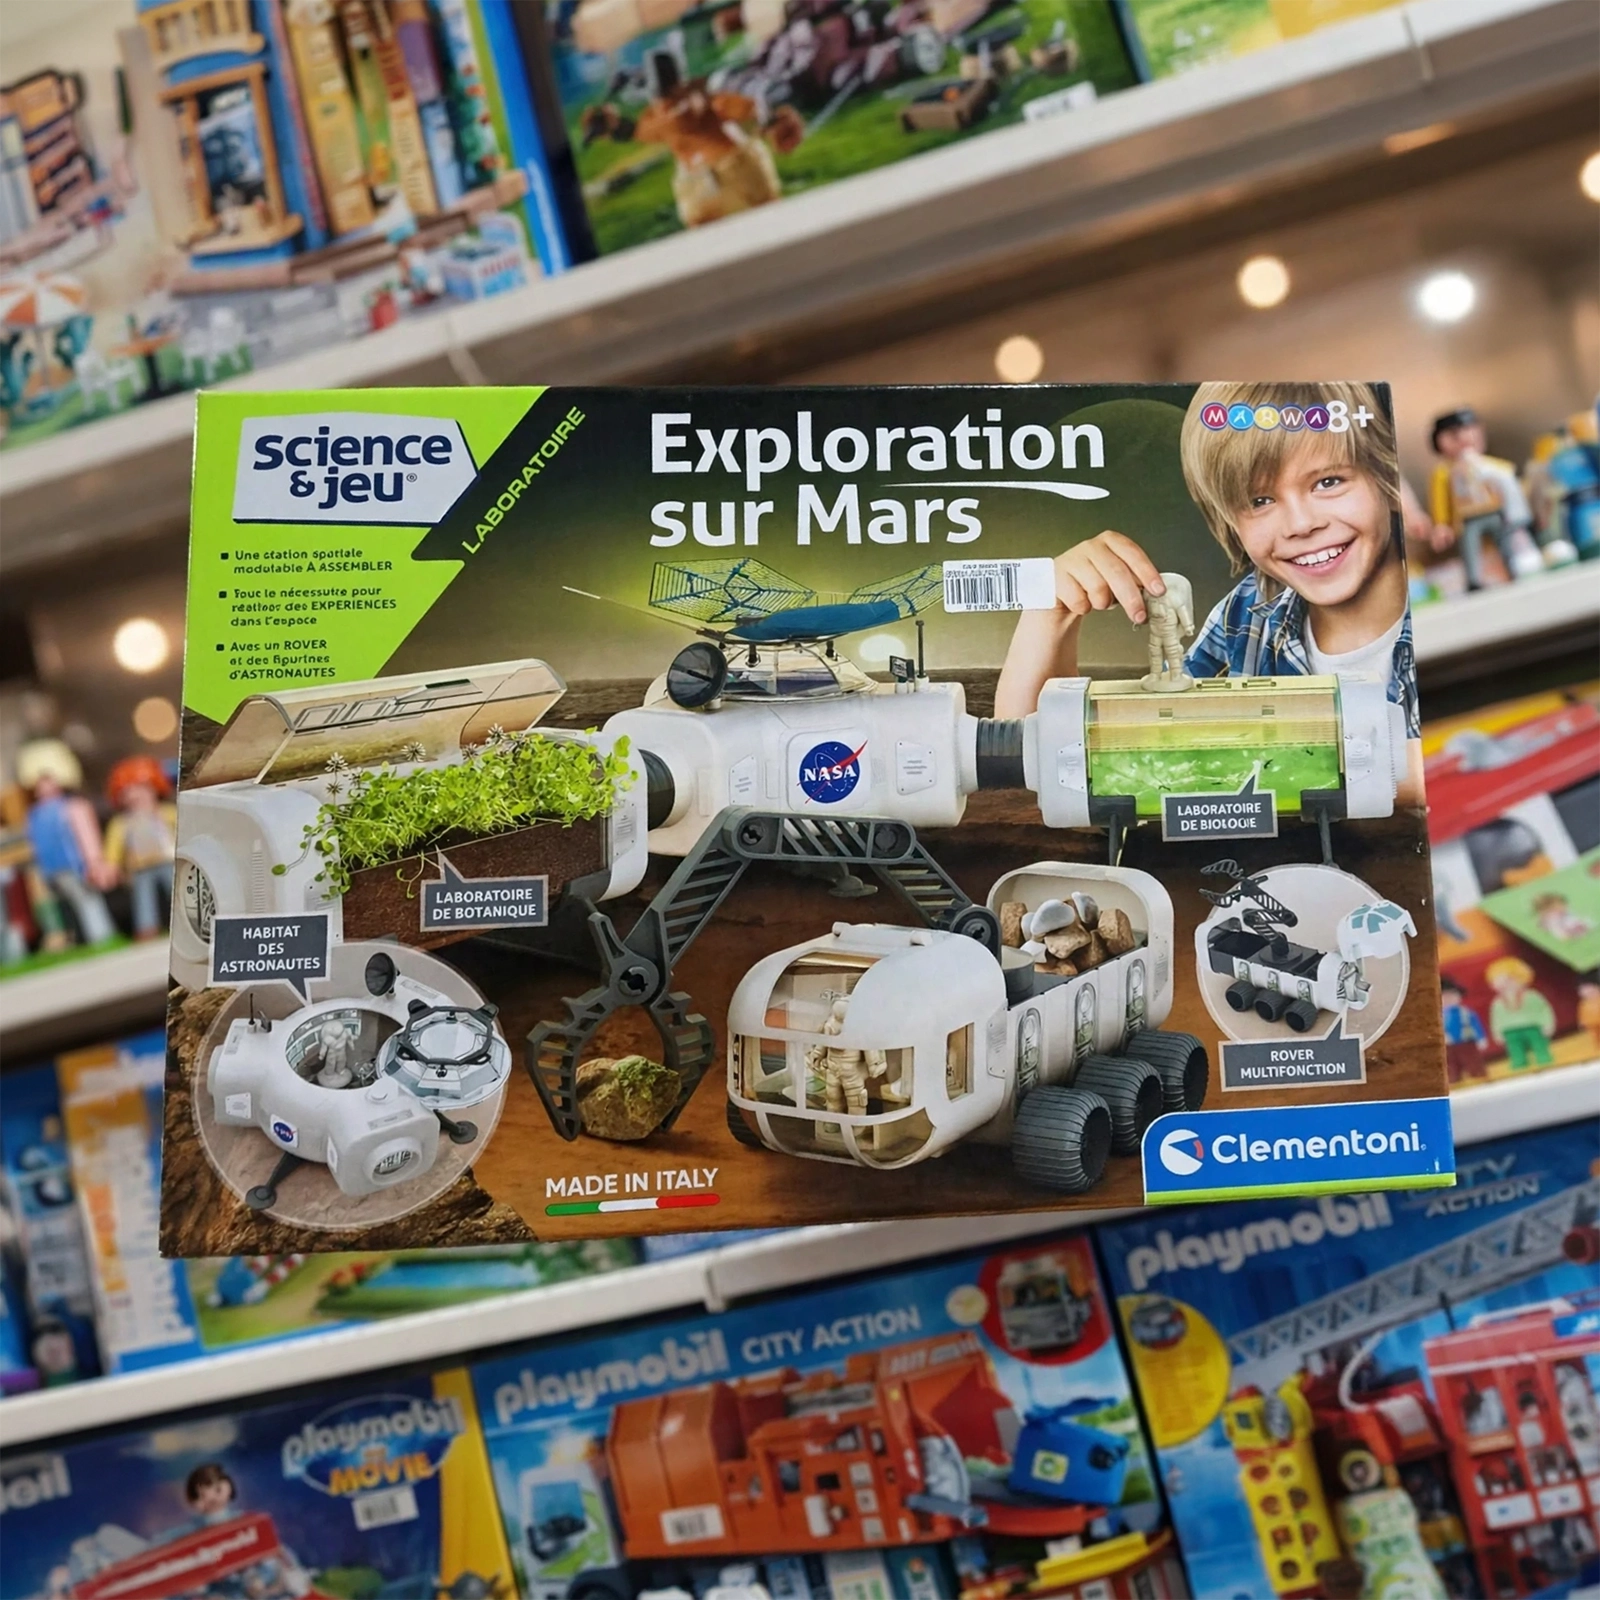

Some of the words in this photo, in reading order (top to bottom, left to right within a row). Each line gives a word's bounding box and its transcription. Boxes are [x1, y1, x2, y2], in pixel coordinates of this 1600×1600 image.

[1326, 400, 1374, 433] 8+
[650, 408, 1105, 492] Exploration
[290, 470, 315, 498] &
[461, 406, 586, 554] LABORATOIRE
[649, 499, 774, 547] sur
[797, 483, 983, 546] Mars
[235, 549, 260, 560] Une
[319, 560, 393, 572] ASSEMBLER
[351, 587, 382, 598] pour
[230, 616, 261, 627] dans
[264, 641, 280, 651] un
[283, 639, 328, 650] ROVER
[803, 764, 857, 783] NASA
[1177, 802, 1262, 817] LABORATOIRE
[1180, 818, 1198, 831] DE
[435, 888, 533, 905] LABORATOIRE
[432, 907, 451, 920] DE
[455, 903, 537, 920] BOTANIQUE
[242, 925, 301, 940] HABITAT
[257, 942, 284, 955] DES
[219, 956, 320, 974] ASTRONAUTES
[1270, 1049, 1314, 1062] ROVER
[1240, 1062, 1346, 1079] MULTIFONCTION
[1211, 1122, 1421, 1165] Clementoni
[546, 1174, 618, 1198] MADE
[624, 1172, 648, 1193] IN
[656, 1168, 719, 1191] ITALY
[1424, 1176, 1541, 1219] ACTION
[1127, 1191, 1394, 1290] playmobil
[492, 1330, 730, 1423] playmobil
[741, 1326, 804, 1366] CITY
[811, 1305, 922, 1350] ACTION
[282, 1397, 466, 1479] playmobil
[330, 1451, 433, 1496] MOVIE
